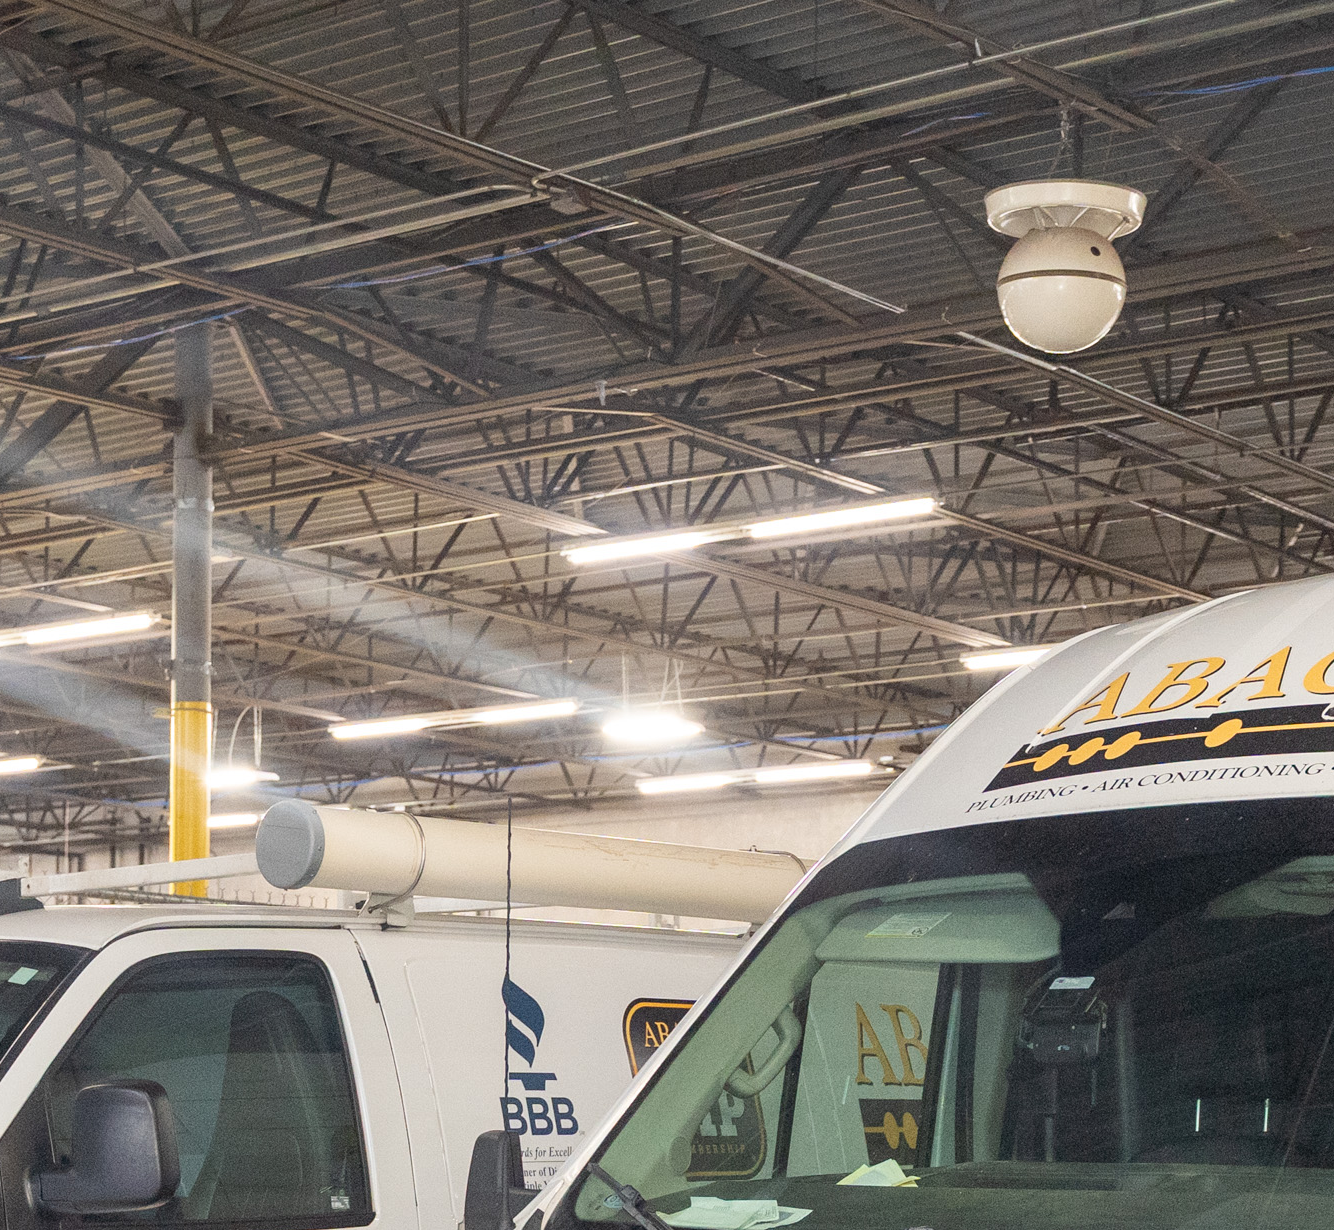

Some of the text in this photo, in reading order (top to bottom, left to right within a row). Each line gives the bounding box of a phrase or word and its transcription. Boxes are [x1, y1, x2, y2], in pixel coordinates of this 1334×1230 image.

[965, 783, 1078, 813] PLUMBING
[1092, 776, 1136, 792] AIR
[1137, 762, 1326, 788] CONDITIONING
[500, 1097, 579, 1135] BBB
